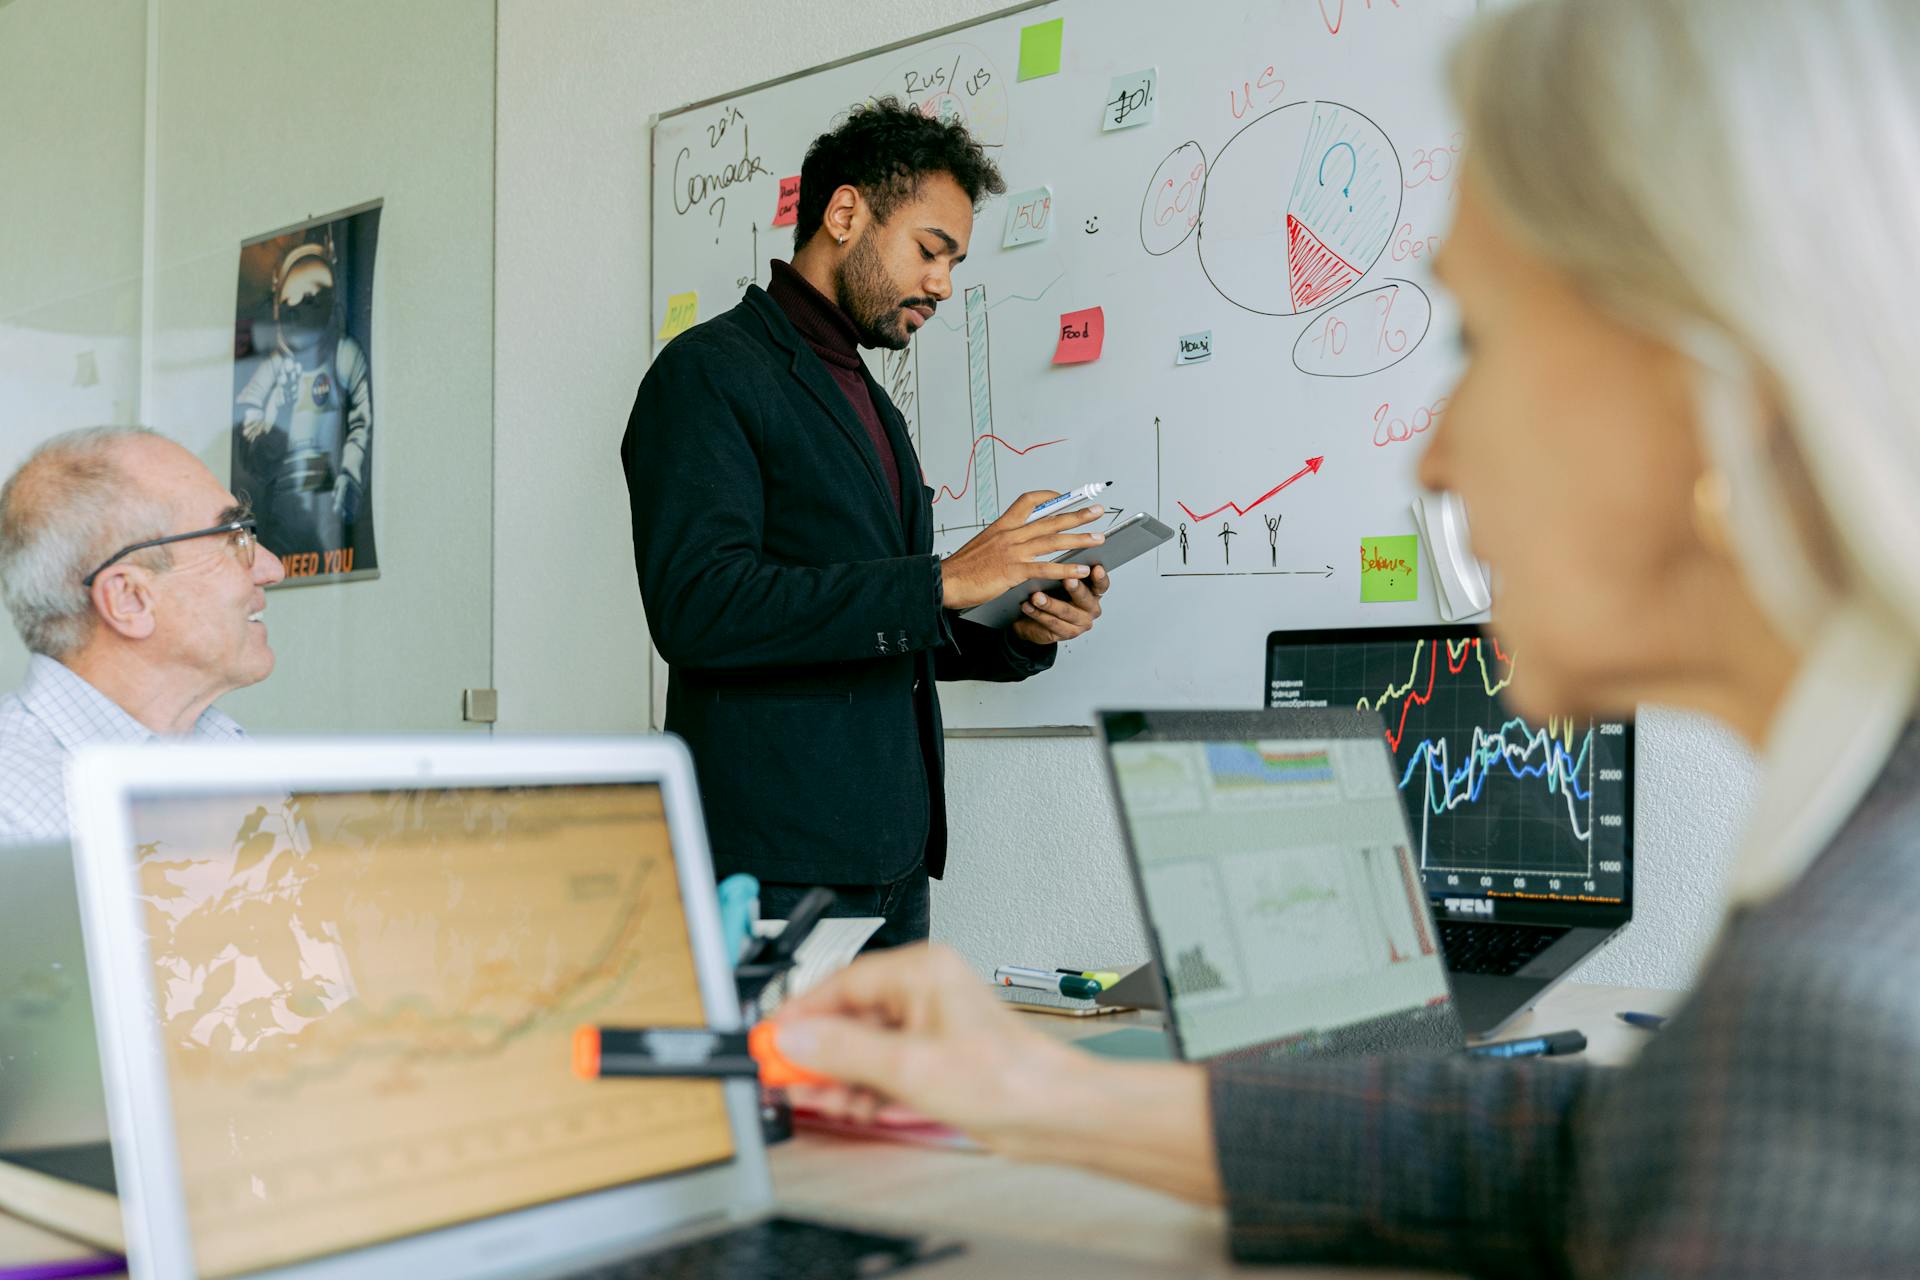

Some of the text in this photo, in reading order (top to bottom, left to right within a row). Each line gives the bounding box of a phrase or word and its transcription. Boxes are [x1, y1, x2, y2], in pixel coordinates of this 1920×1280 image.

[709, 197, 725, 244] ?
[1392, 223, 1442, 261] Ger
[1061, 322, 1088, 341] Food
[324, 547, 354, 576] YOU
[1600, 724, 1622, 735] 2500
[1600, 769, 1622, 780] 2000
[1600, 815, 1622, 826] 1500
[1599, 861, 1621, 872] 1000
[1480, 876, 1492, 887] 00
[1513, 878, 1526, 888] 05
[1549, 879, 1560, 890] 10
